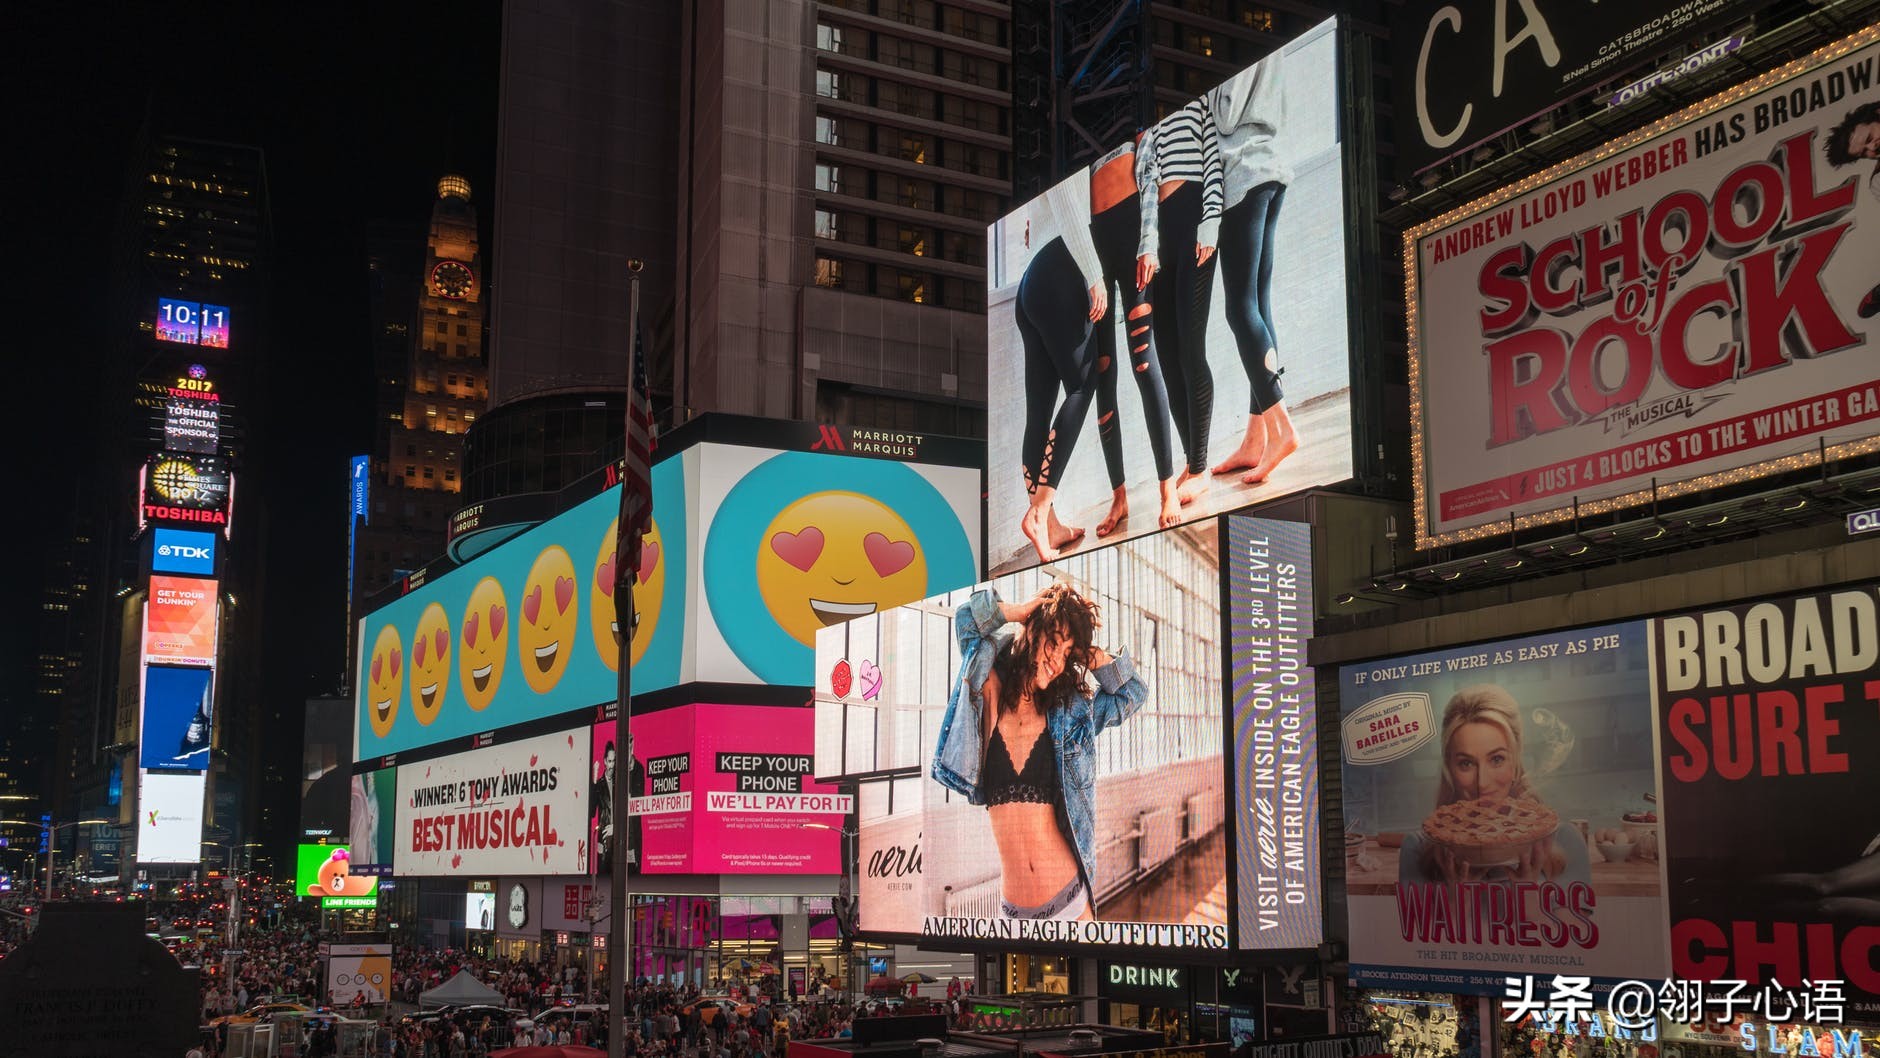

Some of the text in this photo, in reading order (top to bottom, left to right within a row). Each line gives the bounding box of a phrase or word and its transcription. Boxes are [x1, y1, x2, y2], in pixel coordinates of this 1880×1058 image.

[1570, 0, 1725, 80] Neil Simon Theatre 250 West
[1599, 0, 1709, 55] CATSBROADWA
[1415, 0, 1560, 148] CA
[1520, 180, 1587, 230] LLOYD
[1593, 137, 1688, 201] WEBBER
[1695, 112, 1747, 159] HAS
[1754, 58, 1880, 136] BROADW
[1478, 129, 1860, 336] SCHOOL
[1614, 253, 1689, 334] of
[162, 303, 224, 329] 10:11
[1485, 221, 1866, 450] ROCK
[168, 387, 220, 401] TOSHIBA
[177, 377, 213, 392] 2017
[168, 406, 218, 419] TOSHIBA
[178, 417, 217, 428] OFFICIAL
[1610, 395, 1694, 429] THE MUSICAL
[167, 426, 208, 438] SPONSOR
[853, 429, 923, 445] MARRIOTT
[853, 442, 915, 456] MARQUIS
[1534, 466, 1577, 494] JUST
[1583, 462, 1595, 481] 4
[1600, 440, 1672, 478] BLOCKS
[1680, 434, 1703, 459] TO
[1708, 422, 1747, 451] THE
[1754, 400, 1840, 442] WINTER
[355, 481, 364, 514] AWARDS
[145, 505, 225, 524] TOSHIBA
[170, 544, 210, 559] TDK
[157, 590, 205, 599] GET YOUR
[1663, 590, 1880, 693] BROAD
[1354, 634, 1620, 685] IF ONLY LIFE WERE AS EASY AS PIE
[1249, 536, 1278, 930] VISIT aerie INSIDE ON THE 3RD LEVEL
[1277, 562, 1306, 904] OF AMERICAN EAGLE OUTFITTERS
[1356, 720, 1420, 750] BAREILLES
[1370, 714, 1400, 732] SARA
[1668, 690, 1850, 783] SURE
[648, 756, 688, 775] KEEP YOUR
[721, 755, 810, 772] KEEP YOUR
[414, 766, 558, 808] WINNER! 6 TONY AWARDS
[653, 776, 679, 792] PHONE
[742, 776, 798, 792] PHONE
[652, 796, 664, 811] PAY
[666, 796, 682, 810] FOR
[682, 794, 690, 808] IT
[766, 796, 796, 810] PAY
[800, 797, 832, 812] FOR
[836, 797, 850, 811] IT
[412, 805, 557, 853] BEST MUSICAL
[868, 832, 923, 878] aeri
[887, 882, 913, 892] AERIE.COM
[325, 898, 377, 906] LINE FRIENDS
[1396, 880, 1600, 950] WAITRESS
[922, 916, 1226, 950] AMERICAN EAGLE OUTFITTERS
[1416, 950, 1585, 966] THE HIT BROADWAY MUSICAL
[1110, 964, 1180, 988] DRINK
[1360, 970, 1388, 980] BROOKS
[1390, 972, 1429, 982] ATKINSON
[1430, 973, 1464, 984] THEATRE
[1356, 1034, 1384, 1057] BBQ
[1740, 1022, 1863, 1058] SLAM
